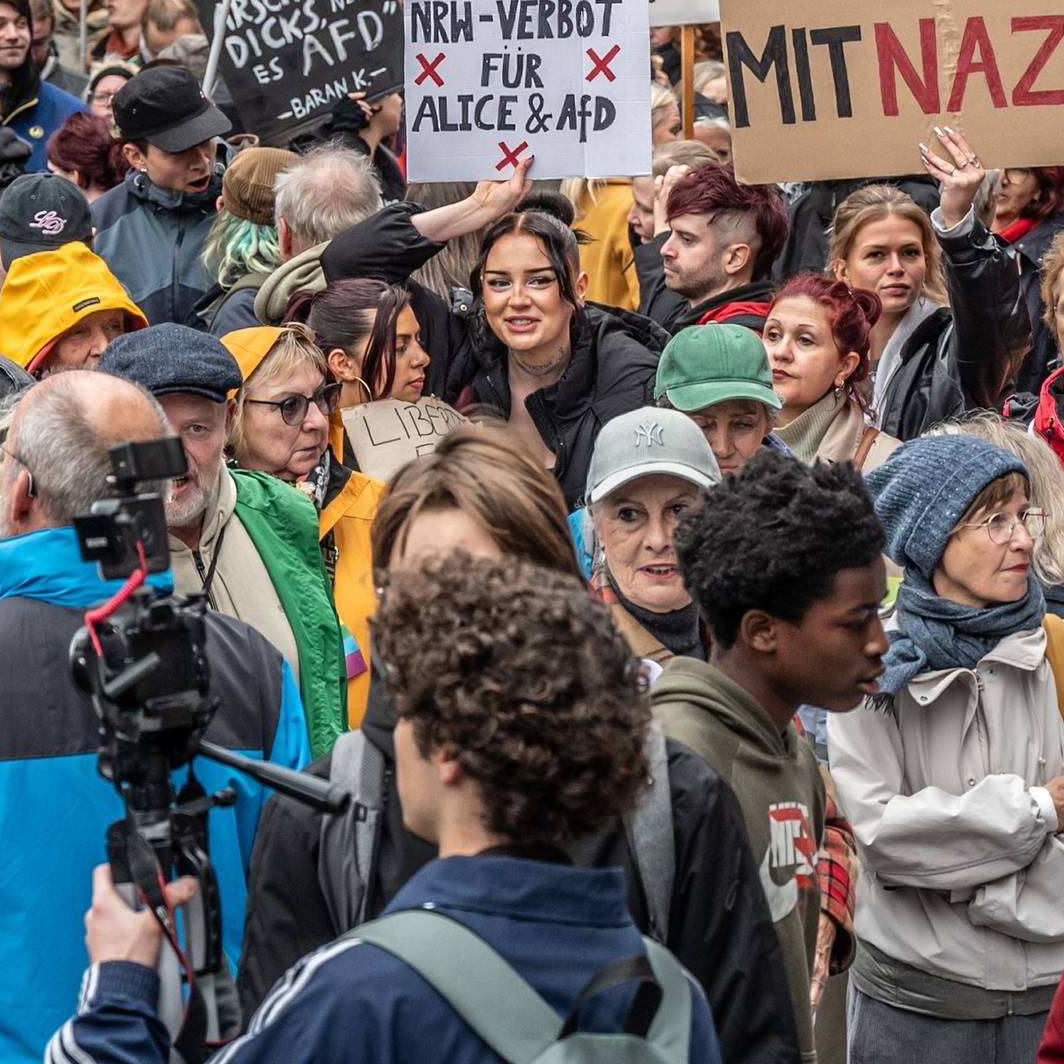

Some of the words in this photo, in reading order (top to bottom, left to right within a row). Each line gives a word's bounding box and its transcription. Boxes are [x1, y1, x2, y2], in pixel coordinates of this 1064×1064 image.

[253, 57, 284, 85] ES
[481, 45, 544, 89] FÜR
[726, 24, 862, 128] MIT
[412, 94, 518, 133] ALICE
[525, 92, 553, 134] &
[556, 94, 617, 143] AfD
